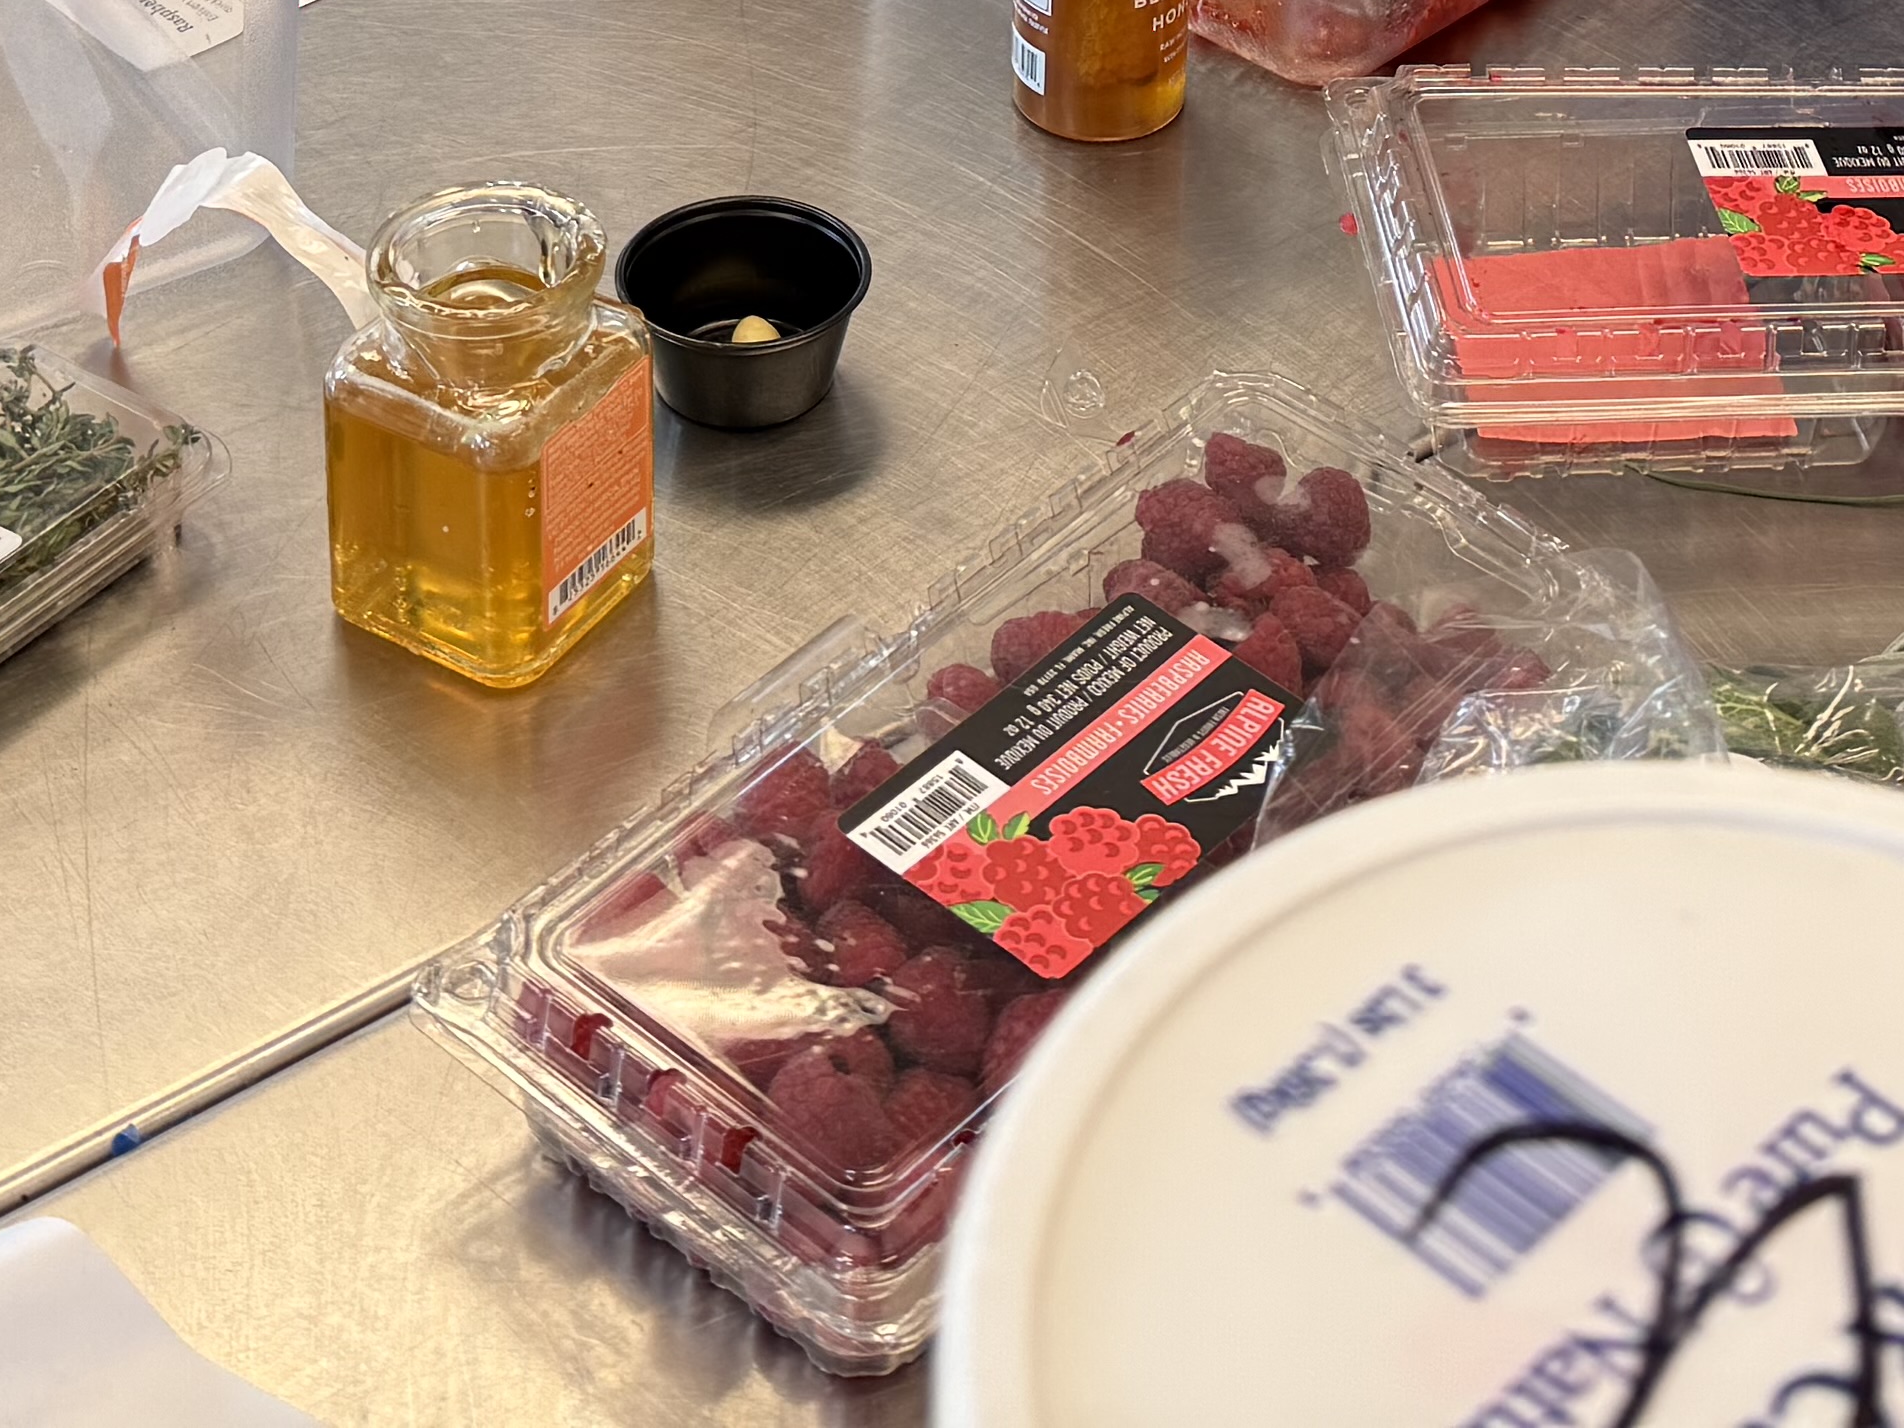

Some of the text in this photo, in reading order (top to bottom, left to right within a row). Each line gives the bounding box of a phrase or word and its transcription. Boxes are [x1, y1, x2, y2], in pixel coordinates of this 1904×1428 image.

[1131, 614, 1156, 634] NET
[1100, 627, 1140, 660] WEIGHT
[1127, 624, 1173, 662] PRODUCT
[1069, 657, 1104, 685] POIDS
[1115, 654, 1138, 672] OF
[1052, 678, 1078, 699] NET
[1085, 664, 1125, 697] MEXICO
[1024, 703, 1042, 717] g
[1034, 691, 1062, 713] 340
[1043, 694, 1088, 730] PRODUIT
[1001, 722, 1020, 737] oz
[1013, 714, 1033, 729] 12
[1030, 650, 1210, 797] RASPBERRIES FRAMBOISES
[1030, 722, 1053, 741] DU
[993, 732, 1041, 771] MEXIQUE
[1151, 696, 1277, 803] ALPINE FRESH
